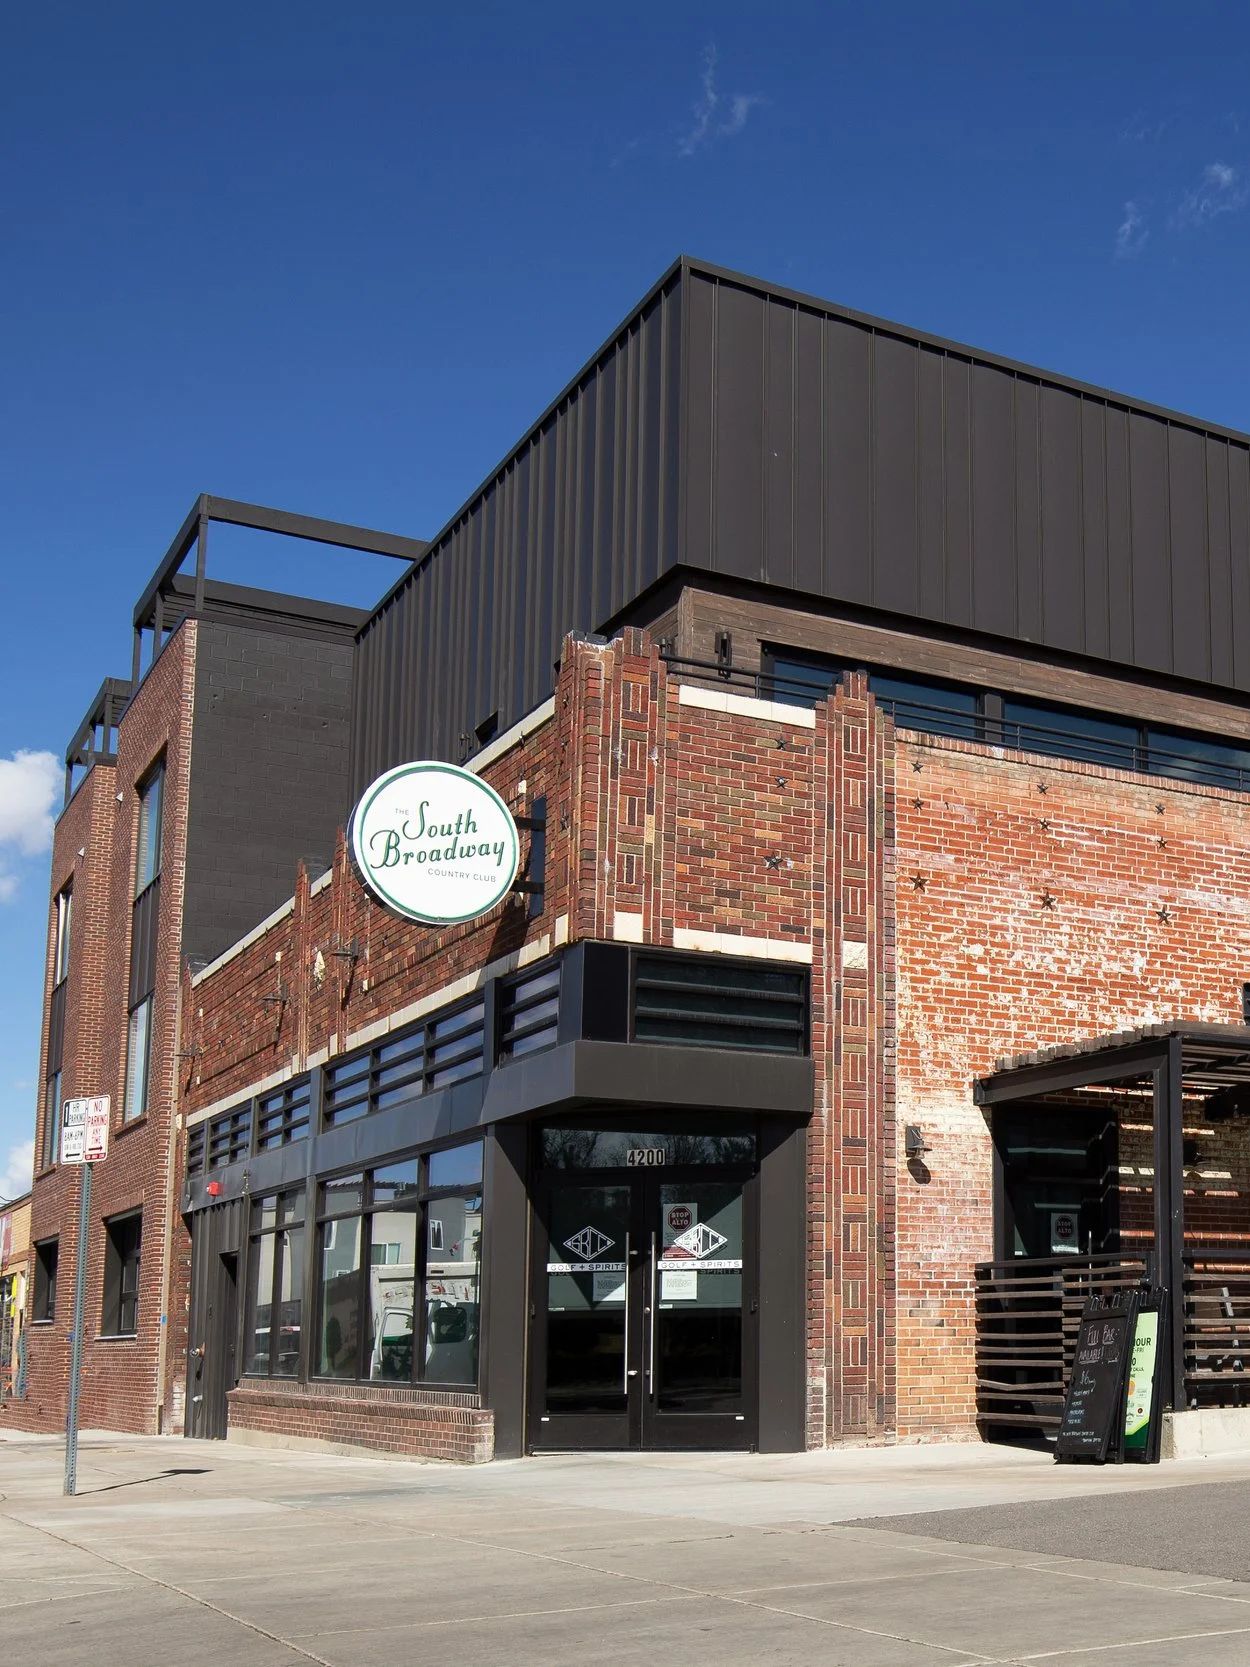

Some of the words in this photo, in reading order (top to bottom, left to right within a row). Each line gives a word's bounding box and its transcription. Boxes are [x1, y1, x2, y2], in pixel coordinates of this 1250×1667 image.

[395, 808, 409, 816] THE
[402, 800, 478, 840] South
[370, 829, 505, 869] Broadway
[428, 868, 470, 879] COUNTRY
[473, 873, 497, 883] CLUB
[73, 1103, 80, 1112] HR
[94, 1100, 103, 1112] NO
[69, 1113, 85, 1124] PARKING
[88, 1114, 107, 1126] PARKING
[92, 1136, 101, 1144] TIME
[628, 1149, 664, 1166] 4200
[588, 1263, 626, 1271] SPIRITS
